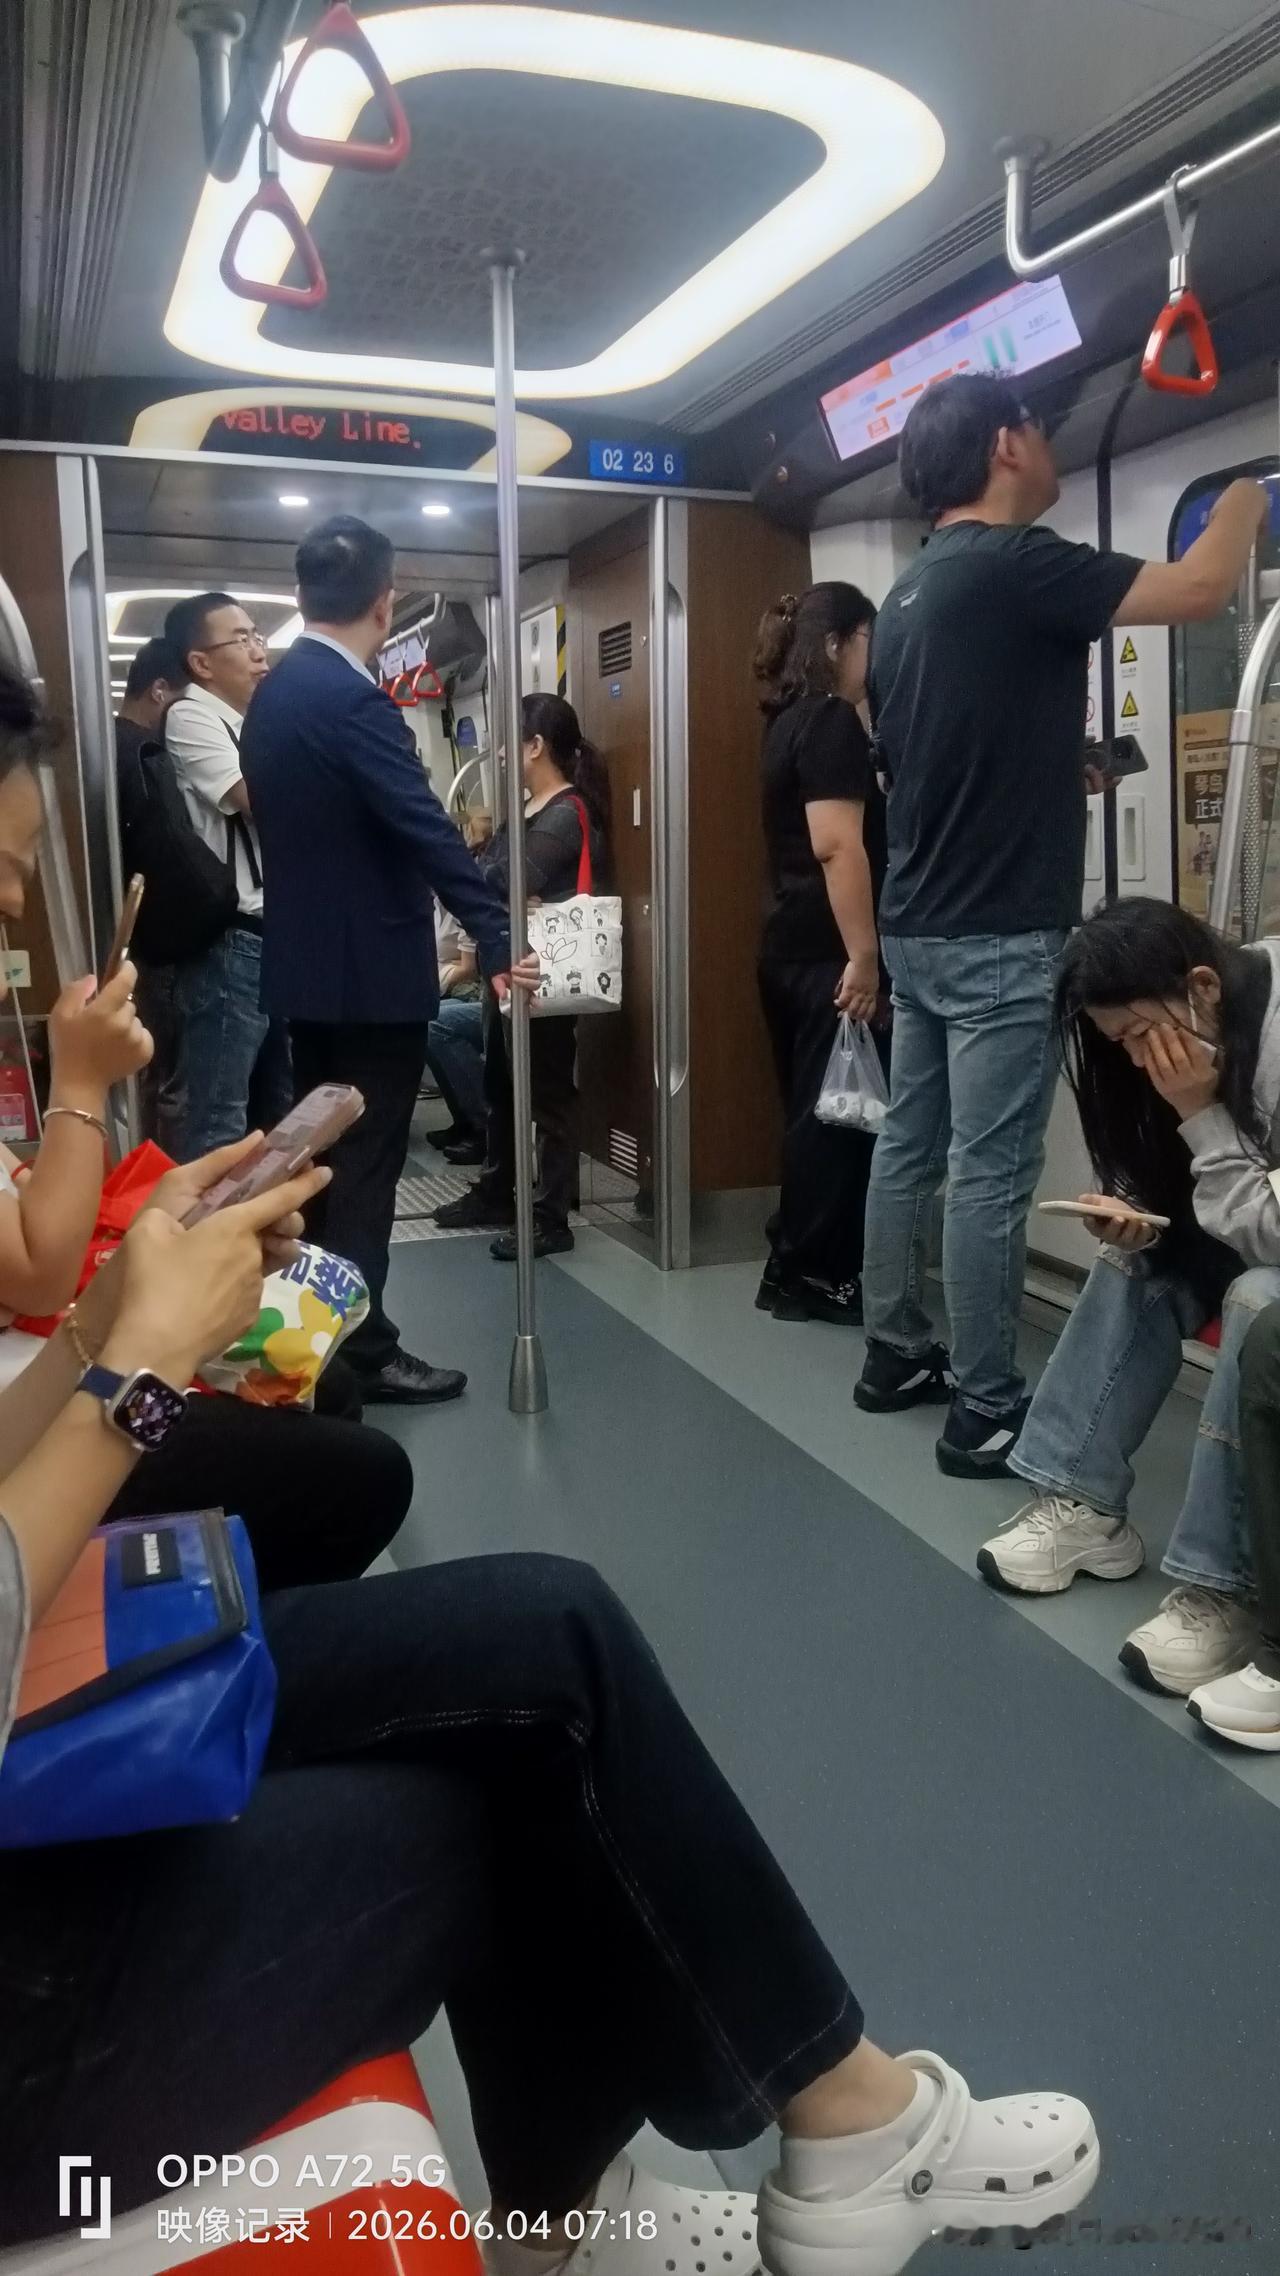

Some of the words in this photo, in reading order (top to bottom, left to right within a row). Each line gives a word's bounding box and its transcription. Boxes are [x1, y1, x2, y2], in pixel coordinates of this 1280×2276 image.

[342, 410, 422, 450] Line.
[602, 448, 623, 471] 02
[633, 450, 654, 473] 23
[664, 453, 674, 475] 6
